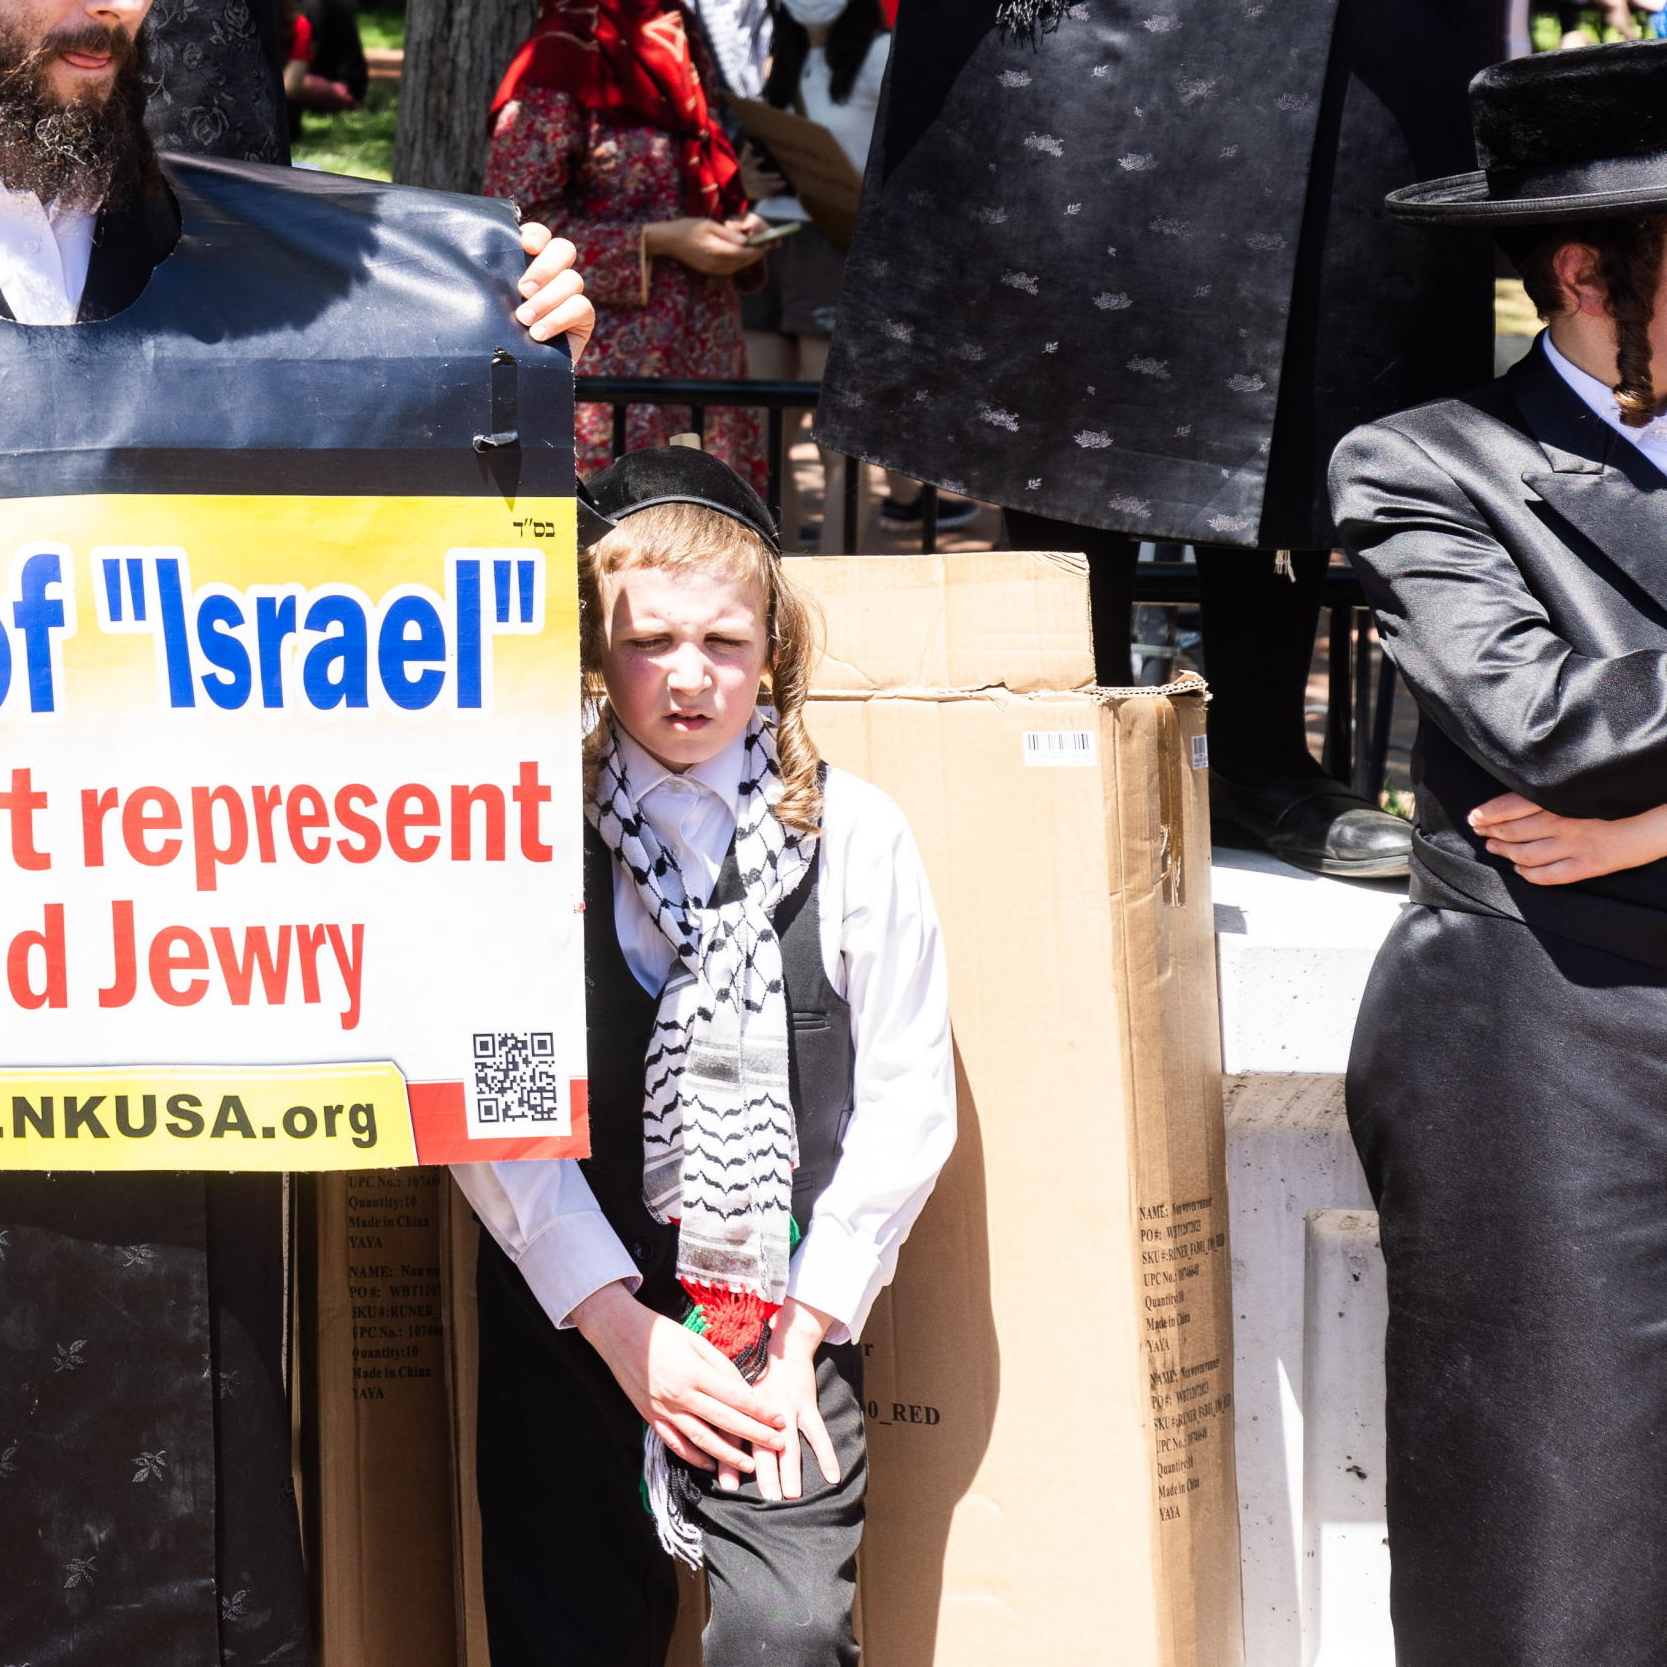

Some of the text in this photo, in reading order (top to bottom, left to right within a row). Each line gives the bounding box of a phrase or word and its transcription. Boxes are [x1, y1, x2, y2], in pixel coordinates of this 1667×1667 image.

[102, 557, 536, 711] "Israel"
[81, 760, 553, 893] represent
[98, 898, 366, 1031] Jewry
[1139, 1204, 1168, 1221] NAME:
[349, 1215, 430, 1228] Made in China
[349, 1236, 384, 1248] YAYA
[349, 1266, 393, 1279] NAME:
[1146, 1317, 1167, 1331] Made
[353, 1365, 432, 1379] Made in China
[868, 1400, 941, 1426] 0_RED
